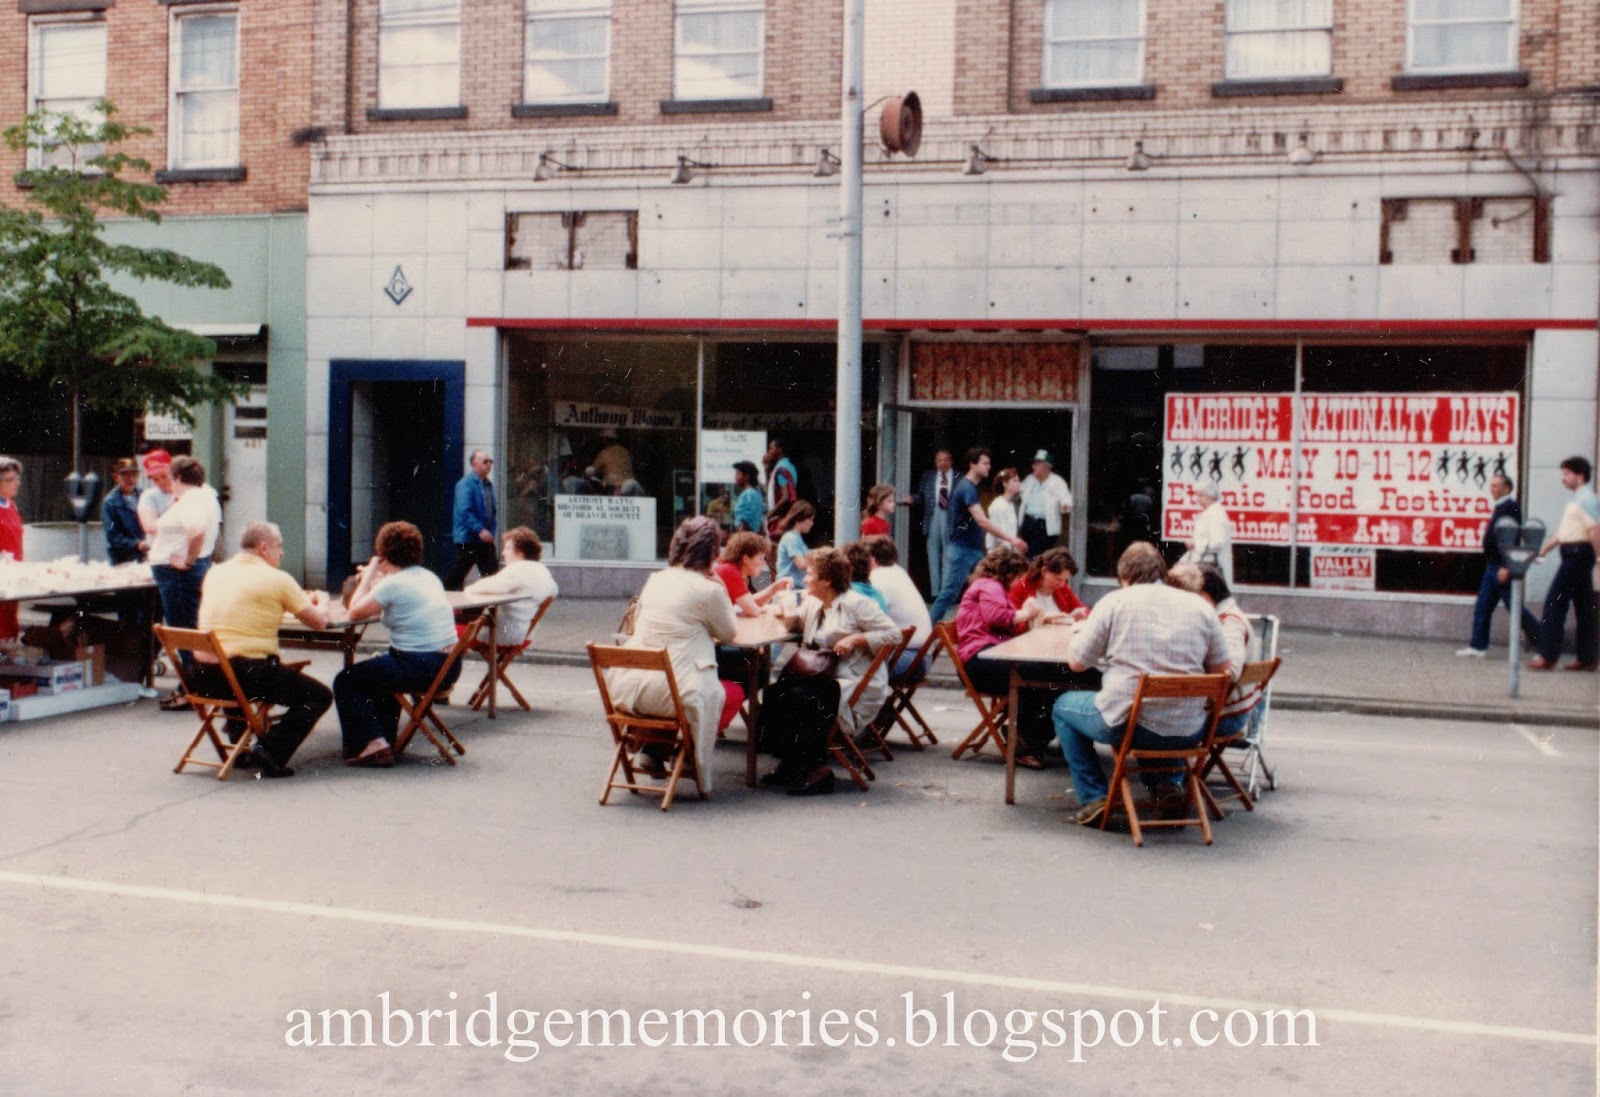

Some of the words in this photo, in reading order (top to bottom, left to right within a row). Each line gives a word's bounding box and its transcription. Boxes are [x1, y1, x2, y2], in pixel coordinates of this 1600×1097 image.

[1170, 397, 1280, 440] AMBRIDGE
[1297, 397, 1438, 443] NATIONALTY
[1450, 397, 1510, 444] DAYS
[1256, 448, 1319, 479] MAY
[1167, 482, 1265, 508] Etnic
[1379, 487, 1492, 514] Festiva
[1353, 516, 1401, 545] Arts
[1411, 517, 1430, 546] &
[1314, 556, 1370, 571] VALLEY
